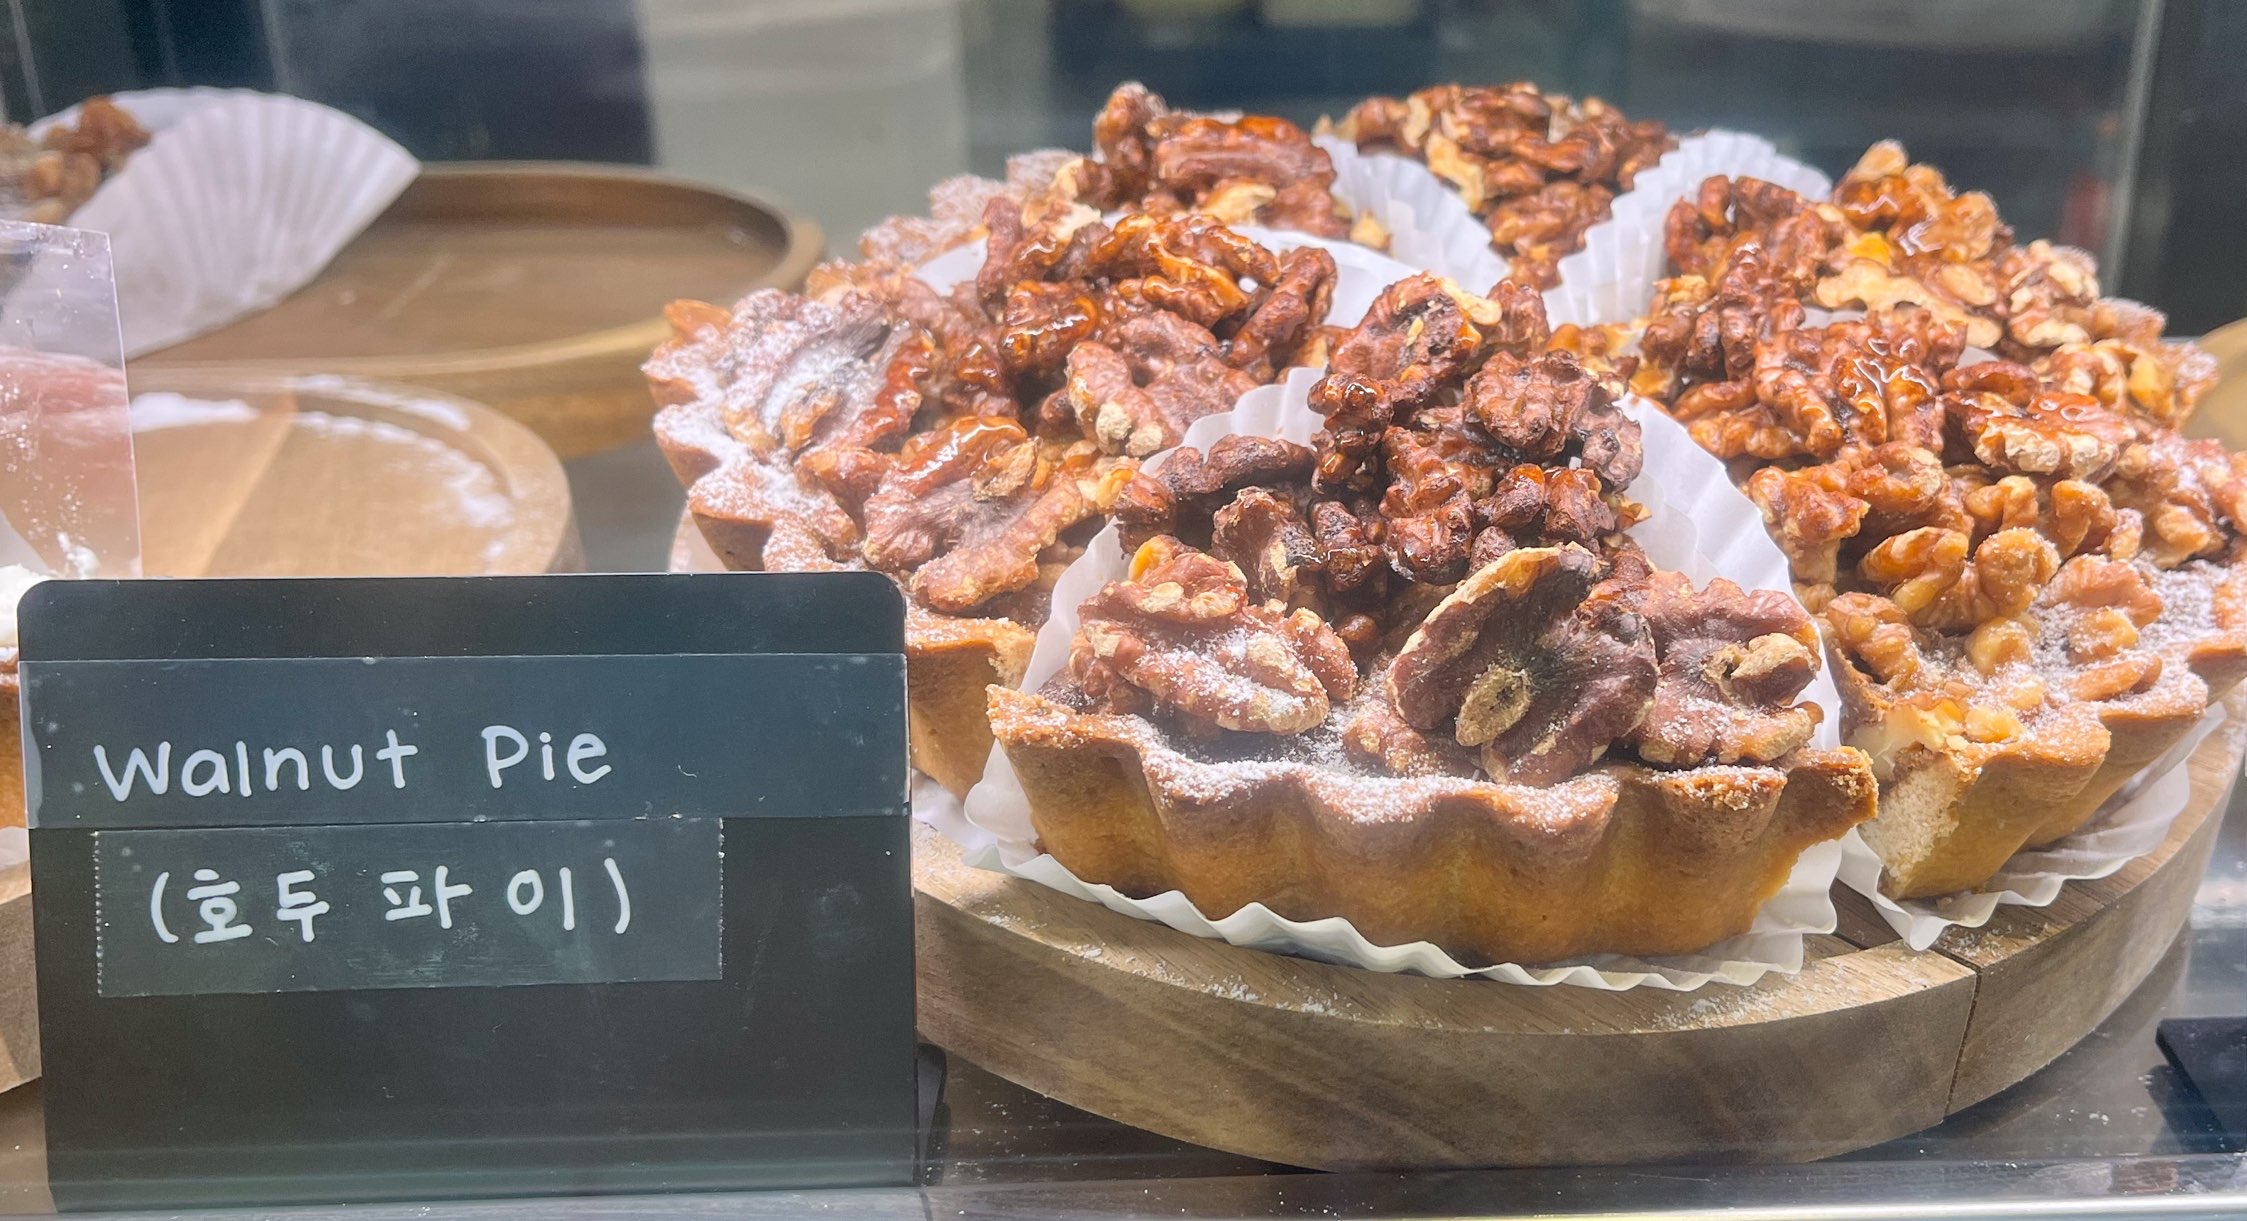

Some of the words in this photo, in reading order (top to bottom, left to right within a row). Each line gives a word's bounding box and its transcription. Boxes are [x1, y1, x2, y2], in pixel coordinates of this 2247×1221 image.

[92, 728, 420, 803] Walnut
[481, 724, 613, 790] Pie
[149, 866, 331, 945] (호두
